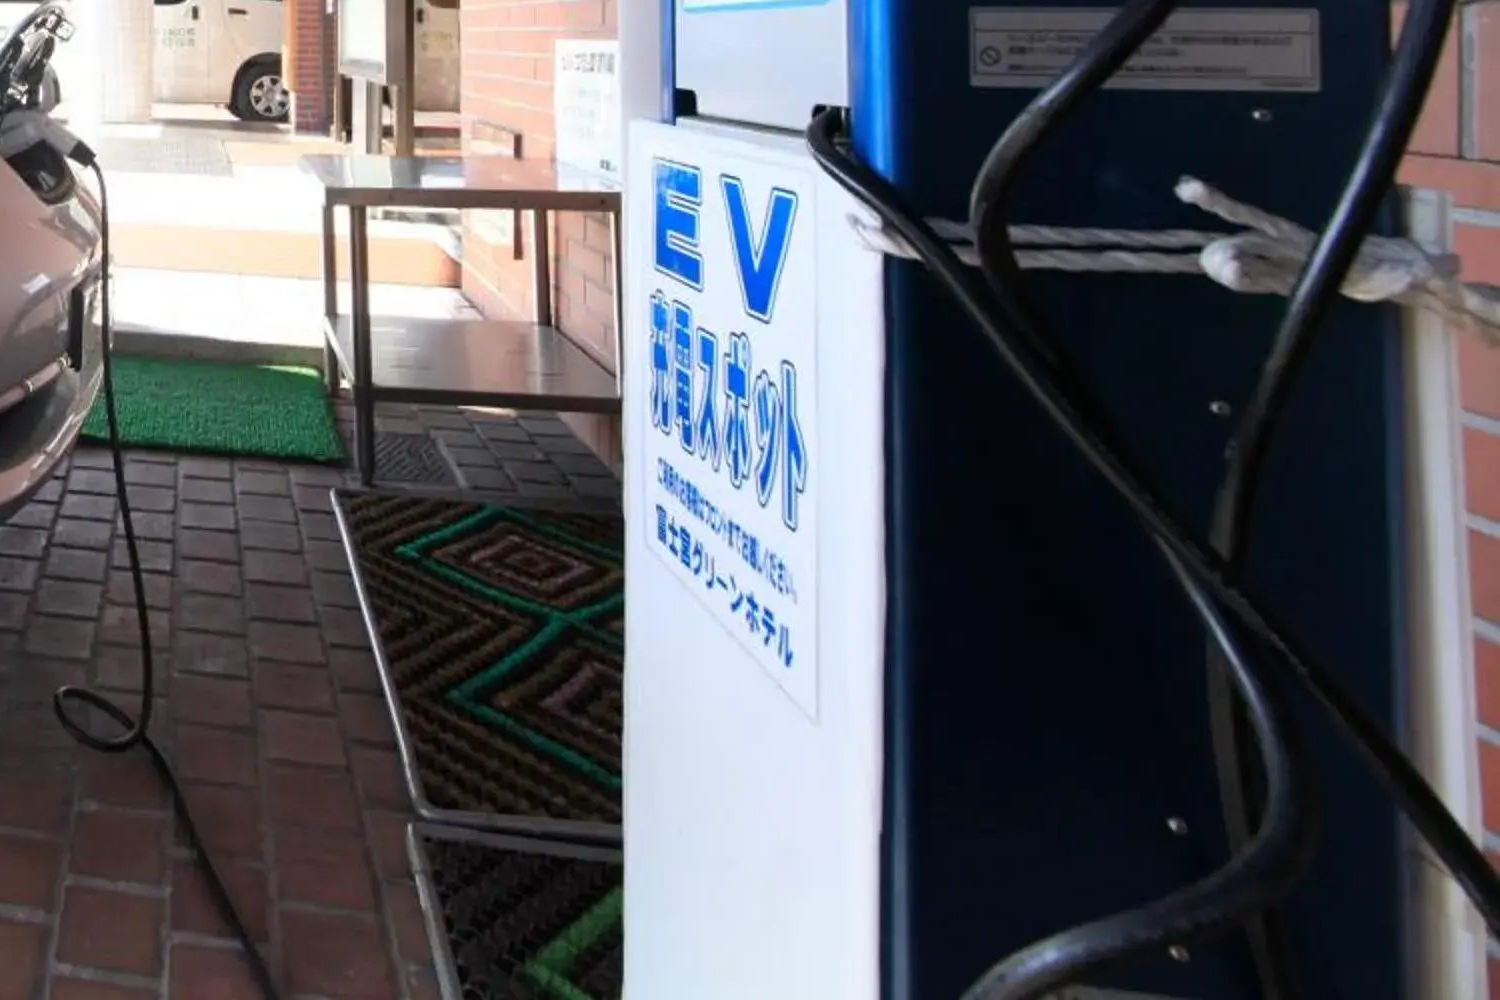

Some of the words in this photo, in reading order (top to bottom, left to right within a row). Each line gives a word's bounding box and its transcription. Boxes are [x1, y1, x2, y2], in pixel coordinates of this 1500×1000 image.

[652, 156, 799, 324] EV
[650, 289, 808, 532] 充電スポット
